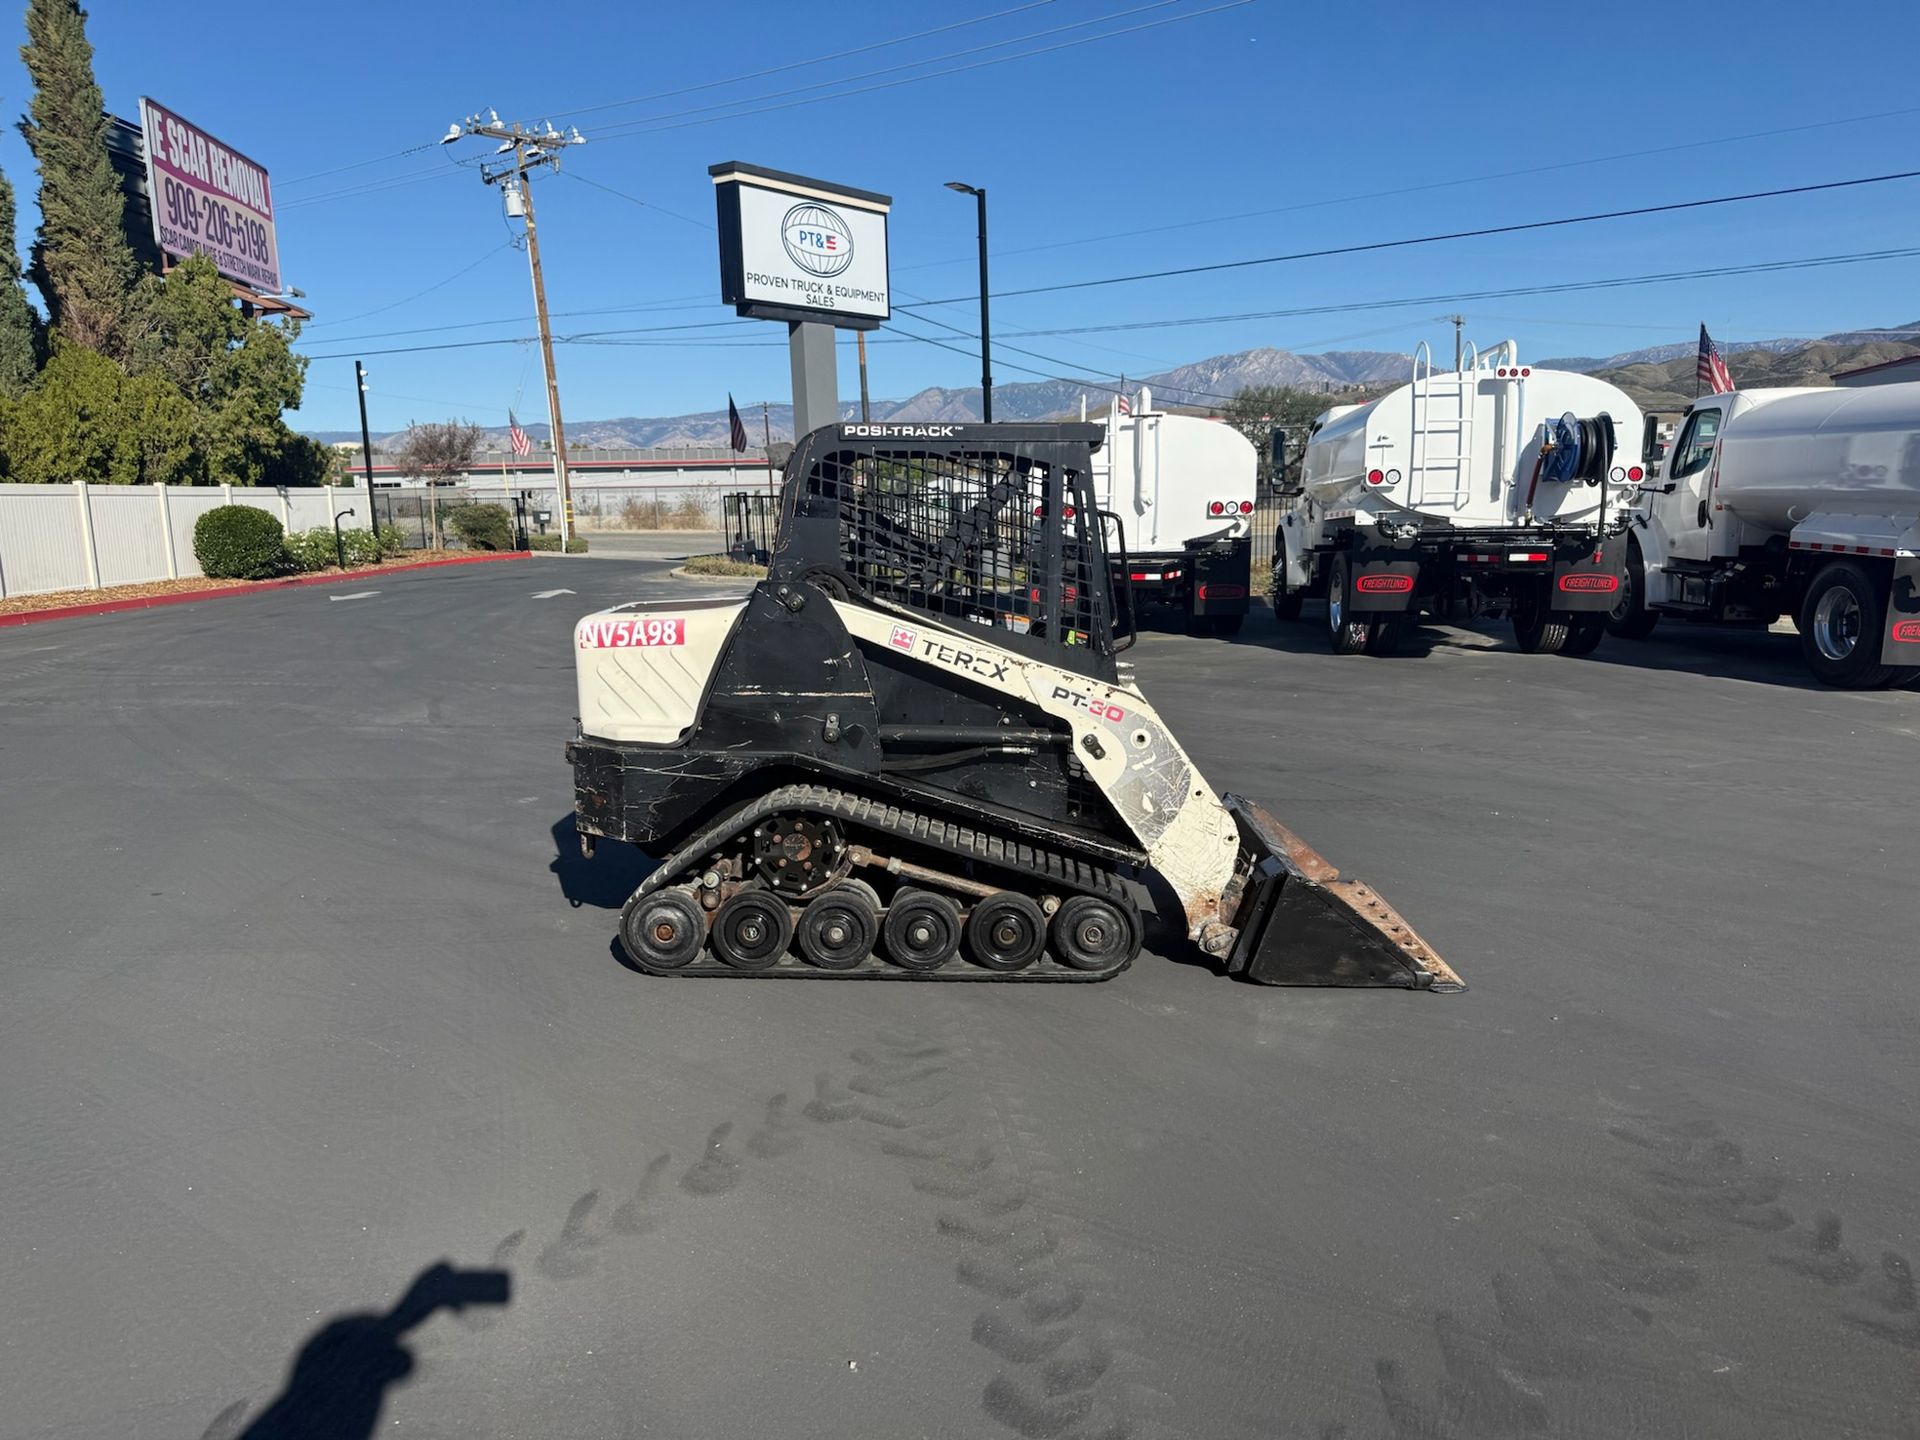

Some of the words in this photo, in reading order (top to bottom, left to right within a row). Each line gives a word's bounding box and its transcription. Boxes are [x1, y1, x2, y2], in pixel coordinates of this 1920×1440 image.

[166, 117, 209, 184] SCAR
[209, 142, 270, 216] REMOVAL
[165, 177, 269, 266] 909-206-5198
[160, 225, 179, 249] SCAR
[223, 252, 247, 275] STRETCH
[799, 230, 837, 250] PT&E
[747, 272, 789, 288] PROVEN
[791, 279, 823, 293] TRUCK
[827, 284, 833, 295] &
[835, 286, 885, 303] EQUIPMENT
[806, 294, 835, 308] SALES
[1362, 578, 1408, 589] FREIGHTLINER
[1565, 577, 1612, 588] FREIGHTLINER
[581, 619, 677, 648] NV5A98
[922, 639, 1010, 682] TEREX
[1051, 686, 1124, 723] PT-30
